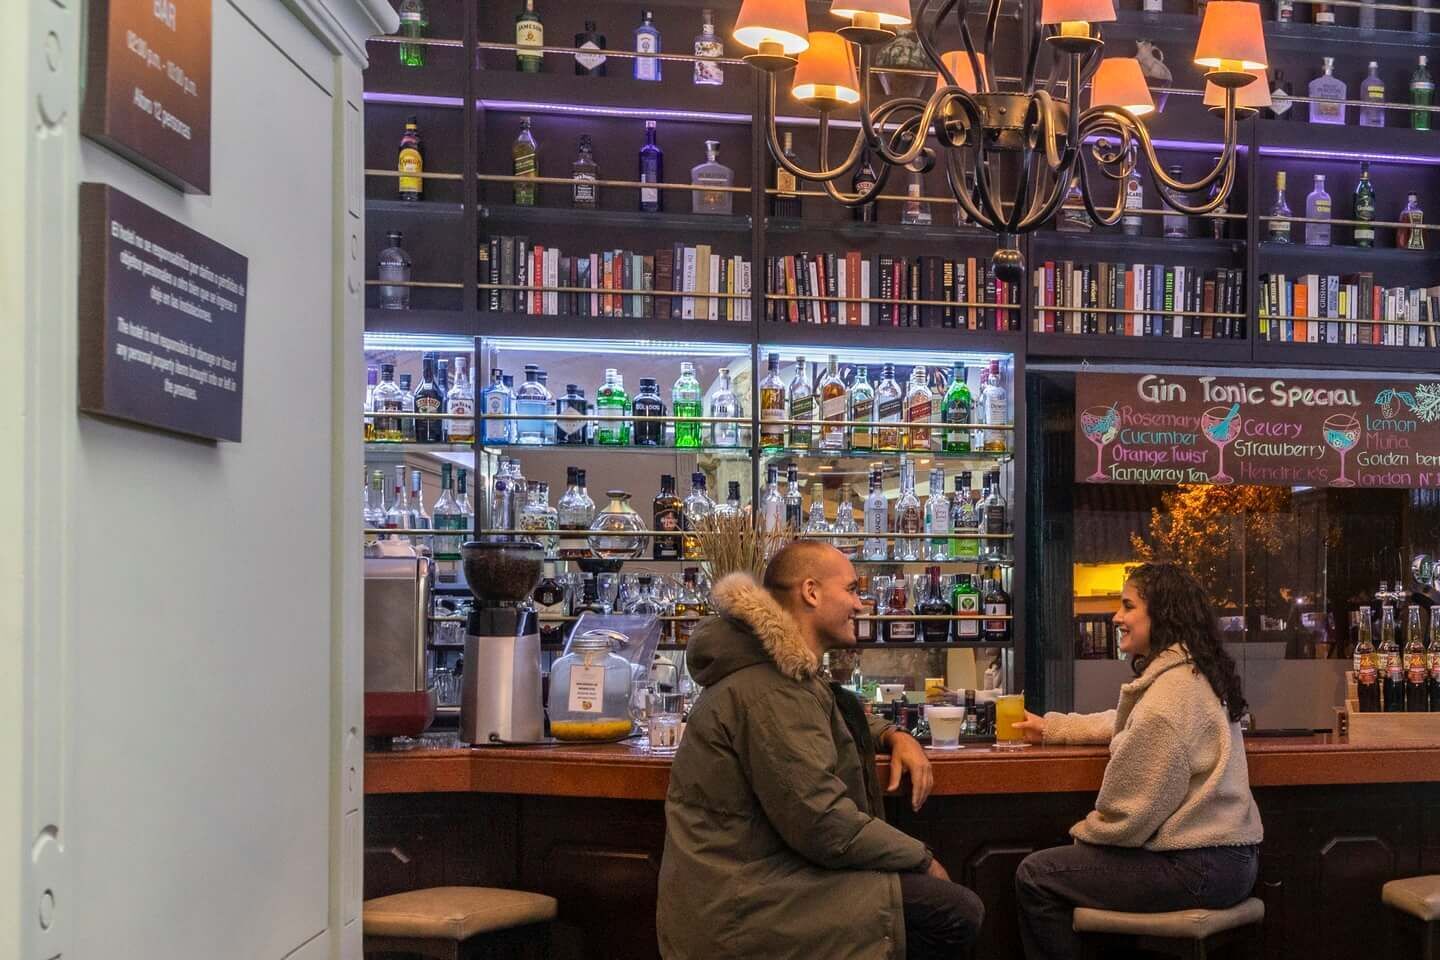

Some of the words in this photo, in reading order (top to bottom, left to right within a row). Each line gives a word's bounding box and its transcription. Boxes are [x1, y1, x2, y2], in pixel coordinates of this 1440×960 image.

[1136, 374, 1187, 404] Gin
[1198, 376, 1265, 406] Tonic
[1121, 406, 1202, 429] Rosemary
[1366, 414, 1417, 434] Lemon
[1120, 428, 1202, 447] Cucumber
[1243, 418, 1304, 439] Celery
[1111, 446, 1168, 466] Orange
[1168, 447, 1212, 465] Twist
[1233, 440, 1327, 460] Strawberry
[1356, 452, 1410, 468] Golden
[1107, 464, 1186, 485] Tanqueray
[1185, 466, 1211, 484] Ten
